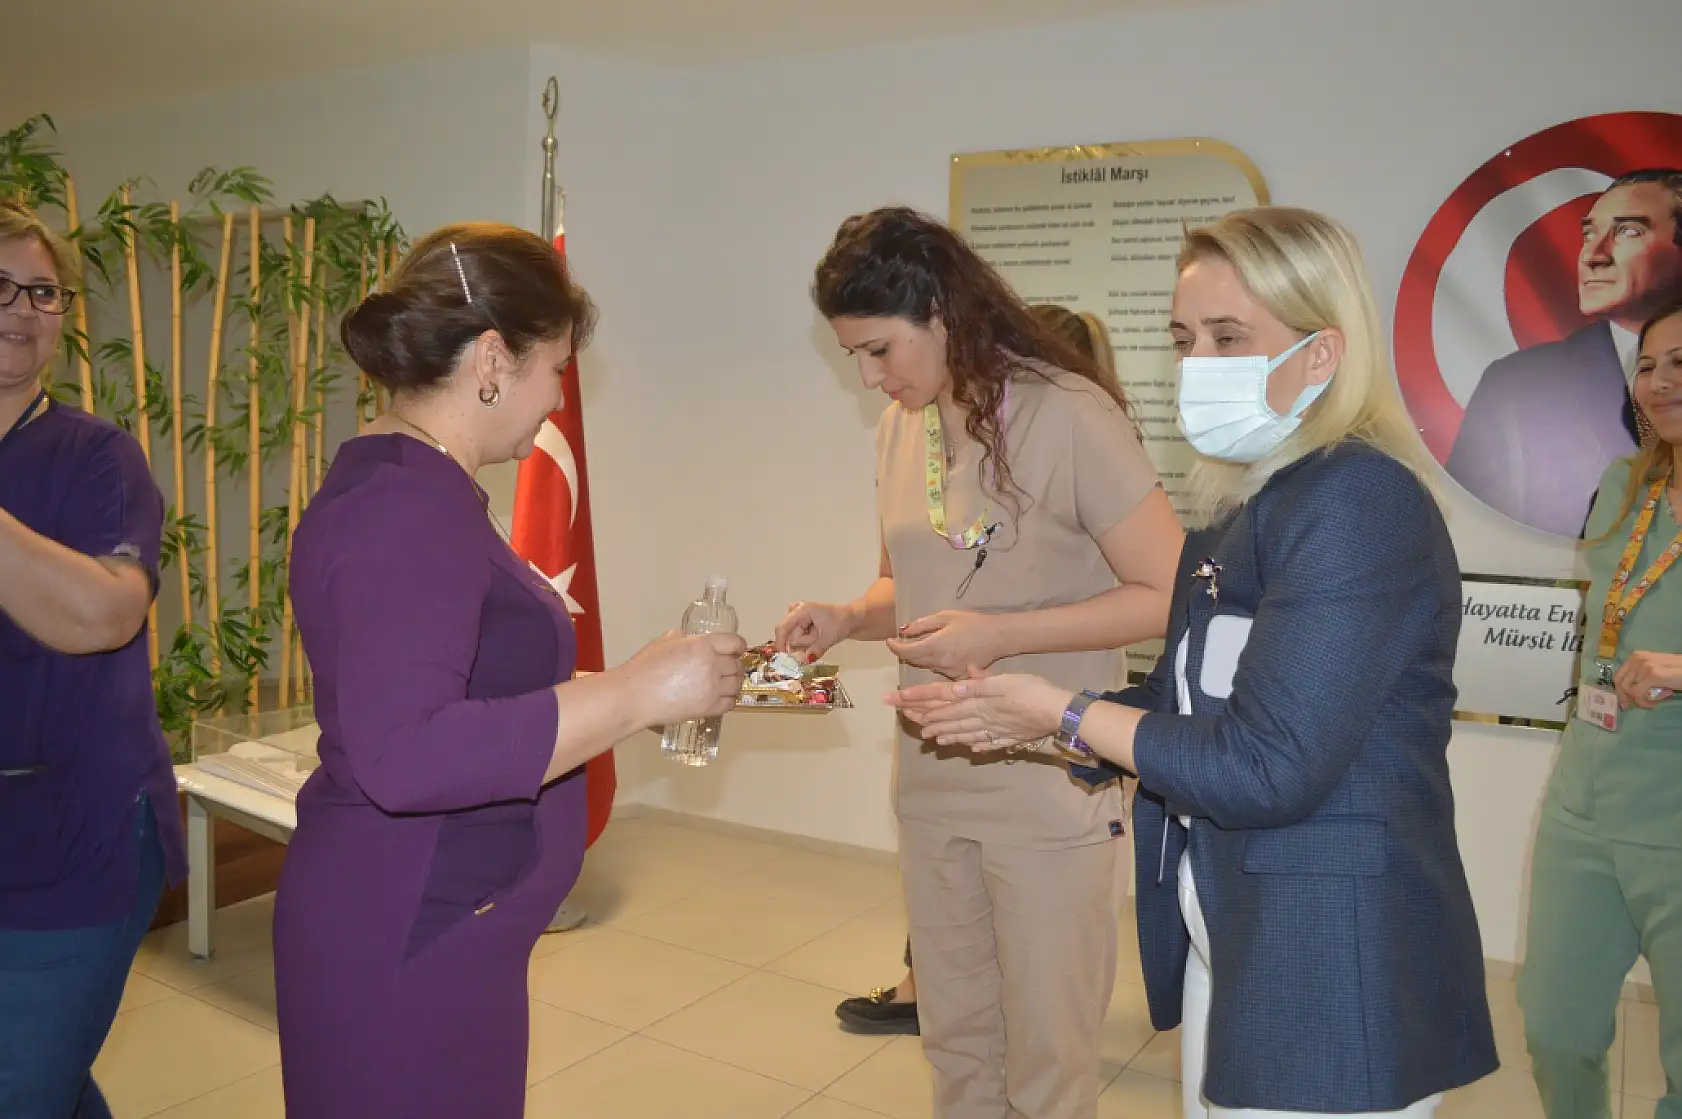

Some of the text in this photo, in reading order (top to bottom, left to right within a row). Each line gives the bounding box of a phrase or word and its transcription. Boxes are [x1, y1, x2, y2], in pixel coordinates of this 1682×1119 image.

[1061, 166, 1149, 184] İstiklâl Marşı
[1547, 604, 1575, 624] En
[1483, 627, 1556, 650] Mürşit
